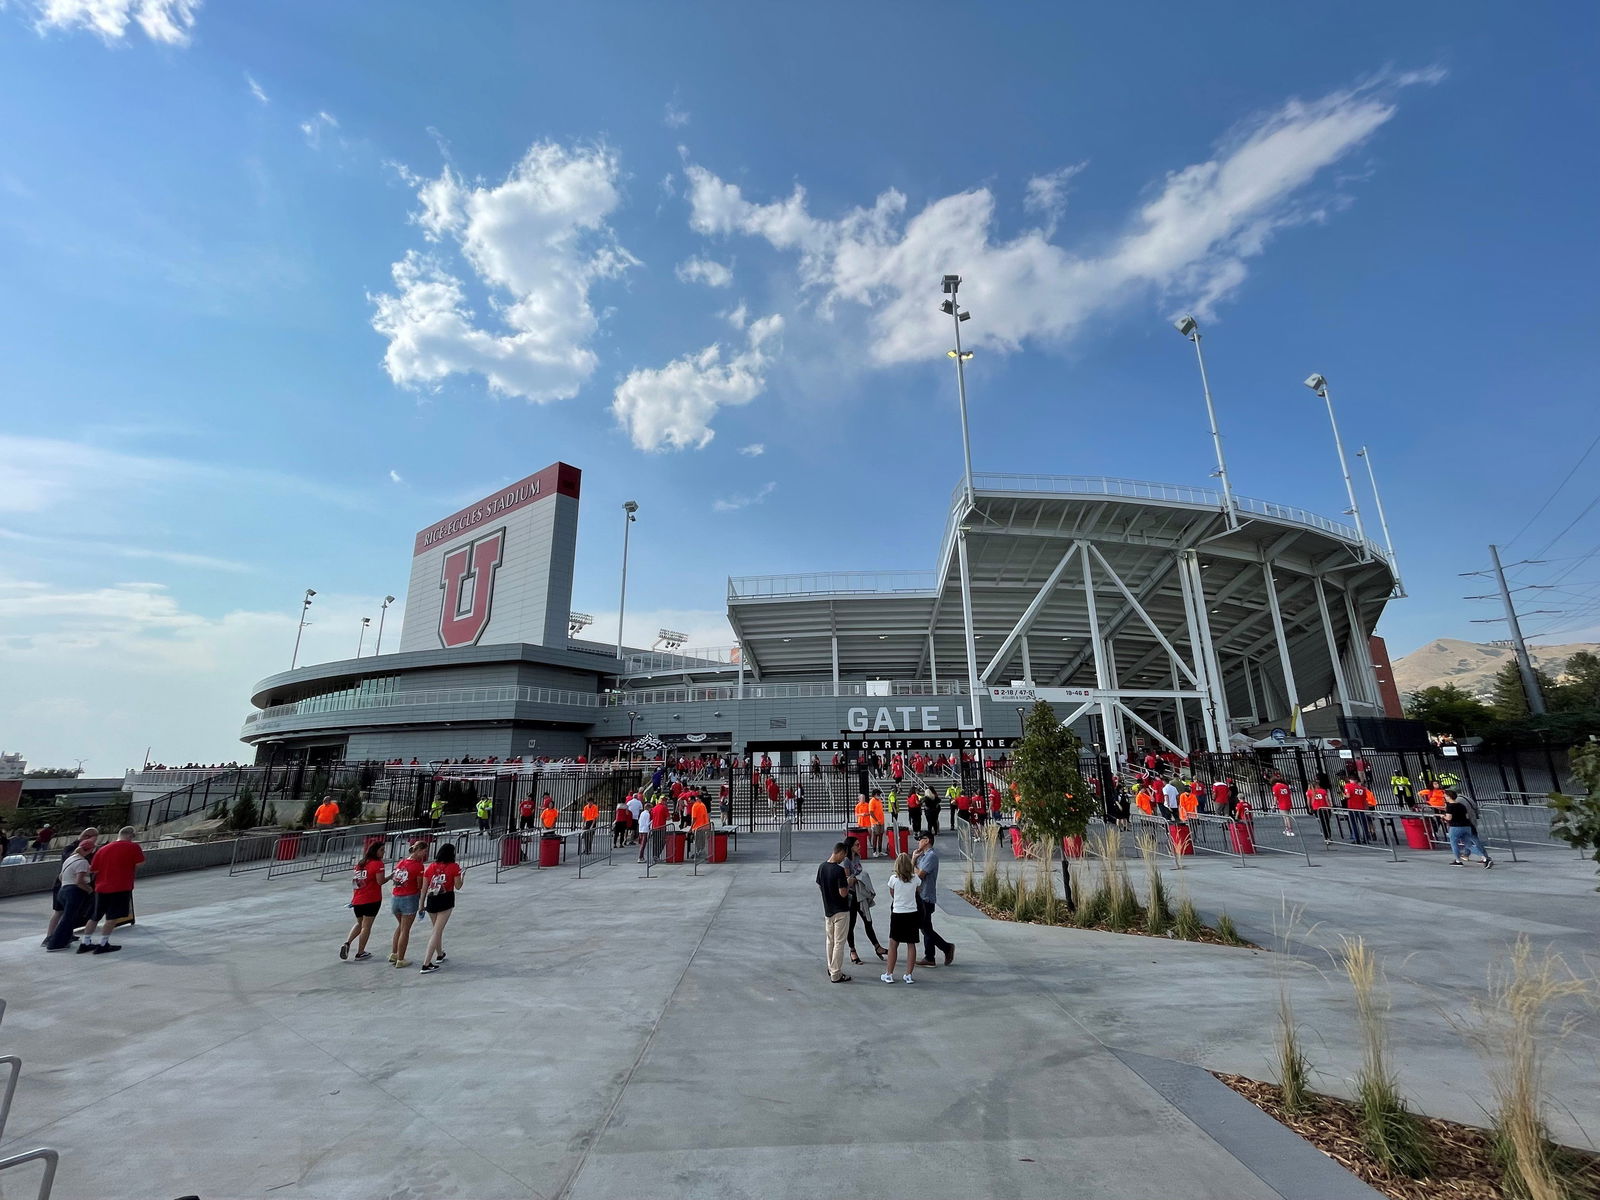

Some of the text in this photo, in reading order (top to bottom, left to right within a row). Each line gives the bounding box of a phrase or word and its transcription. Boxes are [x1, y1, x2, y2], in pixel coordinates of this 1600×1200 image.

[424, 479, 541, 547] RICE-ECCLES STADIUM
[438, 526, 506, 648] U
[847, 705, 976, 732] GATE L
[821, 739, 1006, 749] KEN GARFF RED ZONE
